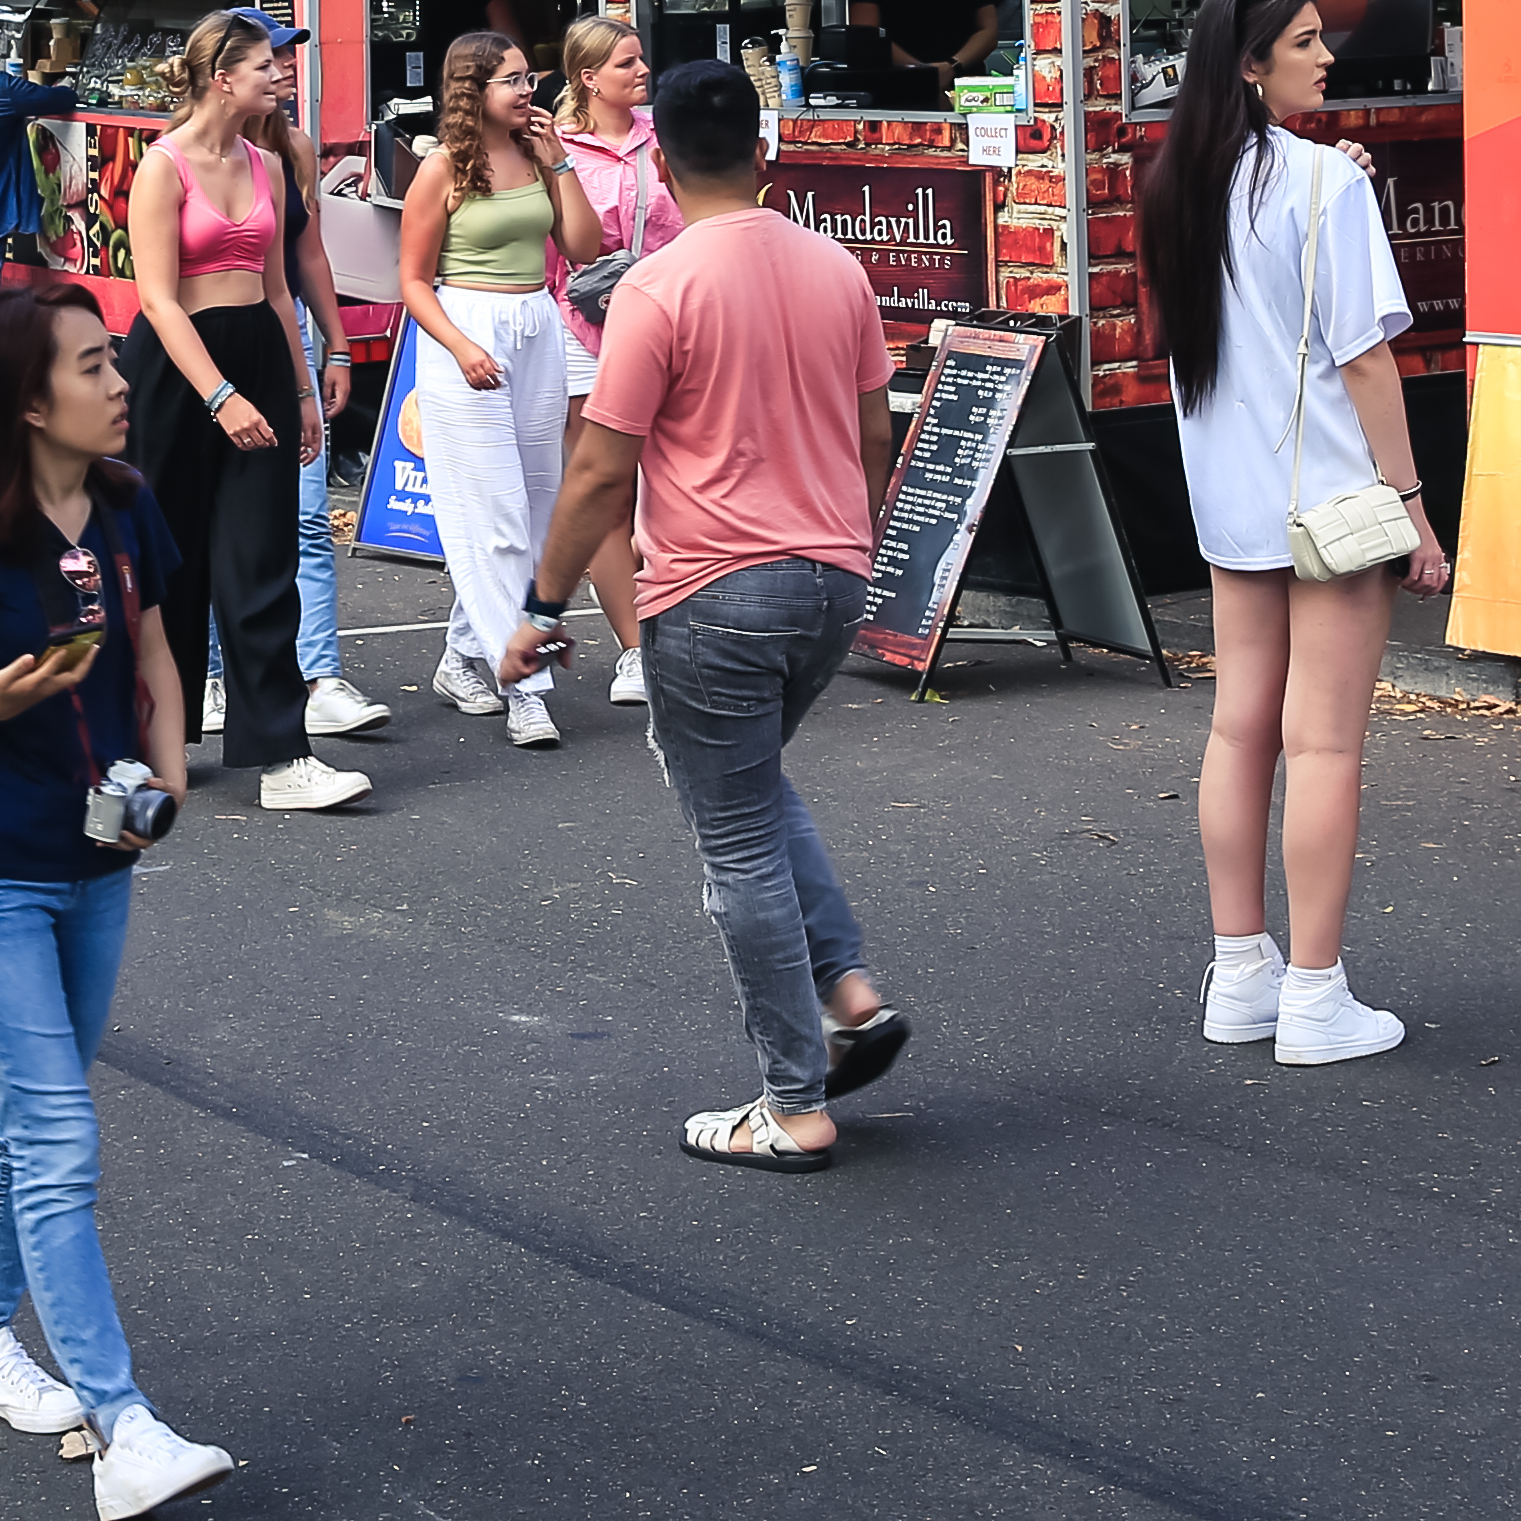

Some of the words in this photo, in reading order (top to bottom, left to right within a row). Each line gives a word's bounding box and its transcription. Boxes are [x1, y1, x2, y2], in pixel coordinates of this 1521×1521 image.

[974, 126, 1009, 139] COLLECT
[981, 145, 1002, 157] HERE
[87, 136, 102, 275] TASTE
[786, 184, 955, 246] Mandavilla
[1381, 177, 1465, 235] Man
[871, 252, 879, 264] &
[889, 252, 952, 269] EVENTS
[1400, 244, 1464, 263] ERIN
[875, 286, 971, 313] andavilla.com
[393, 460, 431, 495] VIL
